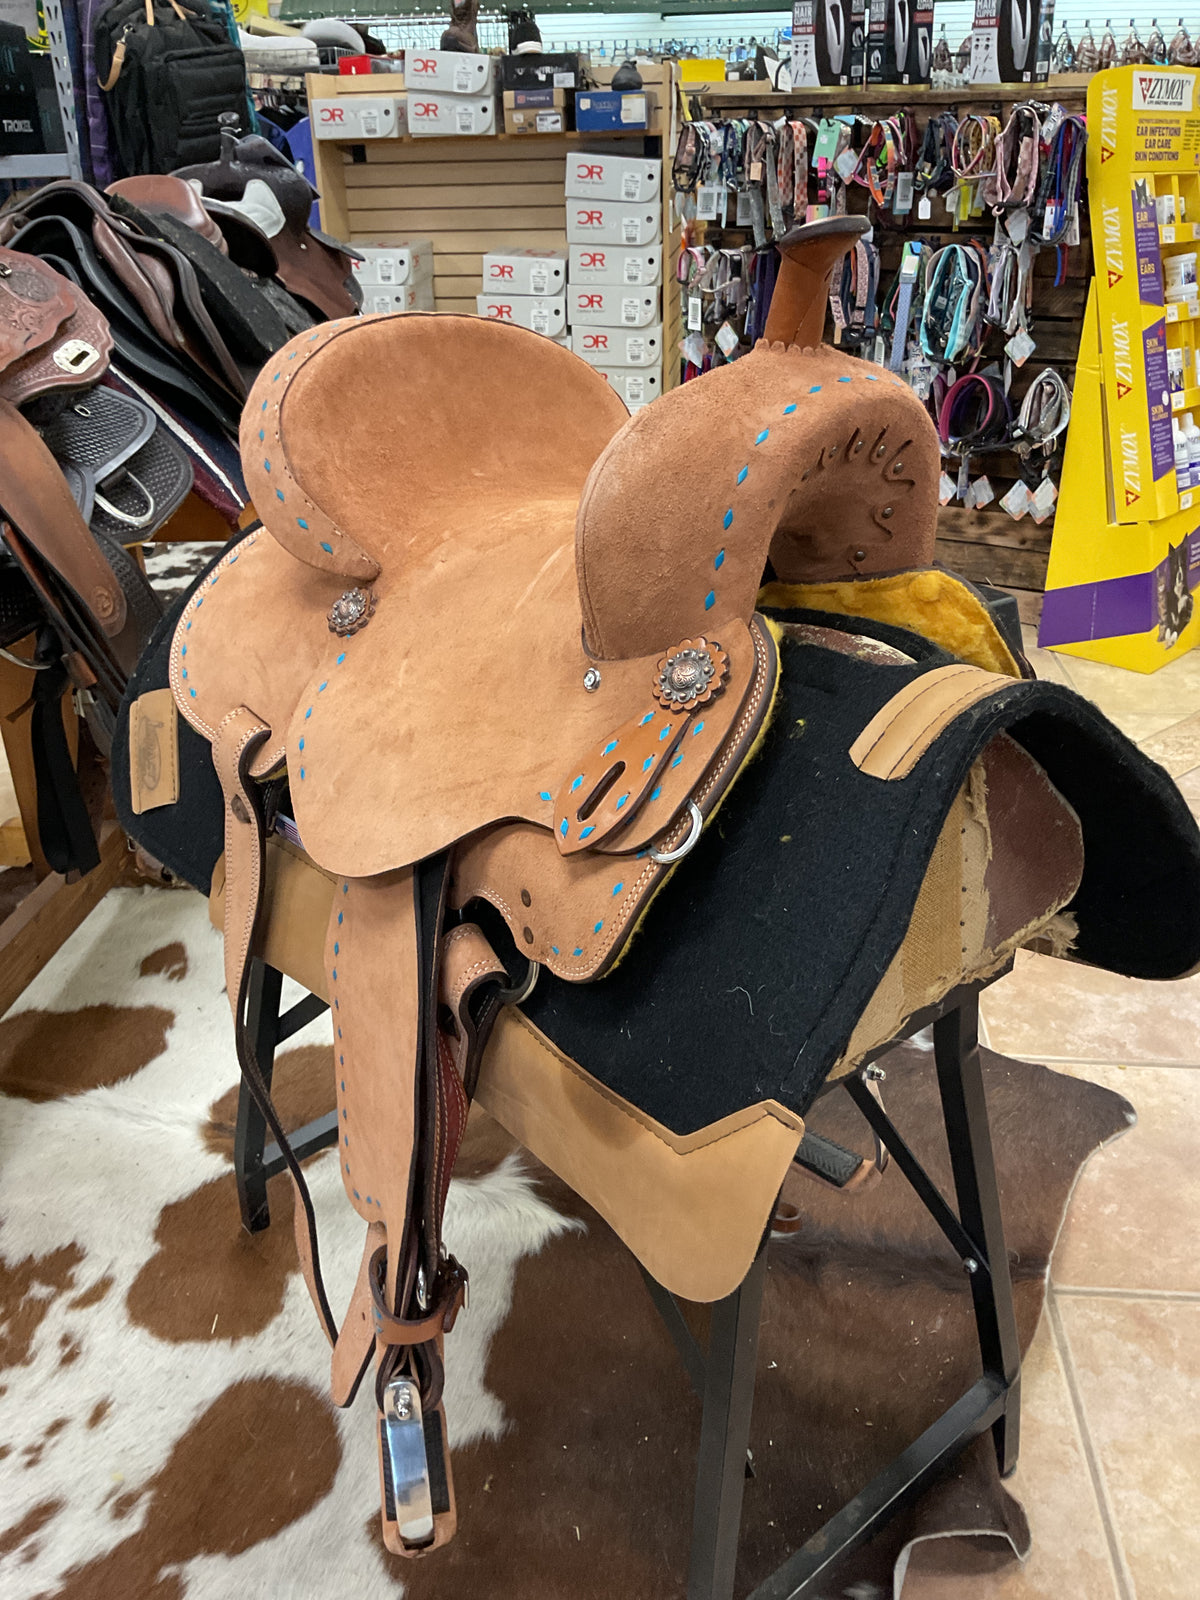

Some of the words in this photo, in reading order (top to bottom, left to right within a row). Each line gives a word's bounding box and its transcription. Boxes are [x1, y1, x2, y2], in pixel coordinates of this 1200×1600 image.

[794, 5, 813, 18] HAIR
[1149, 78, 1186, 100] ZYMOX
[1101, 83, 1118, 148] ZYMOX
[1137, 126, 1148, 136] EAR
[1149, 127, 1181, 136] INFECTIONS
[1145, 139, 1156, 149] EAR
[1157, 139, 1172, 149] CARE
[1135, 151, 1147, 161] SKIN
[1149, 151, 1179, 161] CONDITIONS
[1136, 211, 1148, 222] EAR
[1102, 202, 1123, 271] ZYMOX
[1141, 263, 1155, 275] EARS
[1146, 337, 1159, 349] SKIN
[1112, 319, 1133, 383] ZYMOX
[1151, 404, 1164, 416] SKIN
[1120, 428, 1141, 491] ZYMOX
